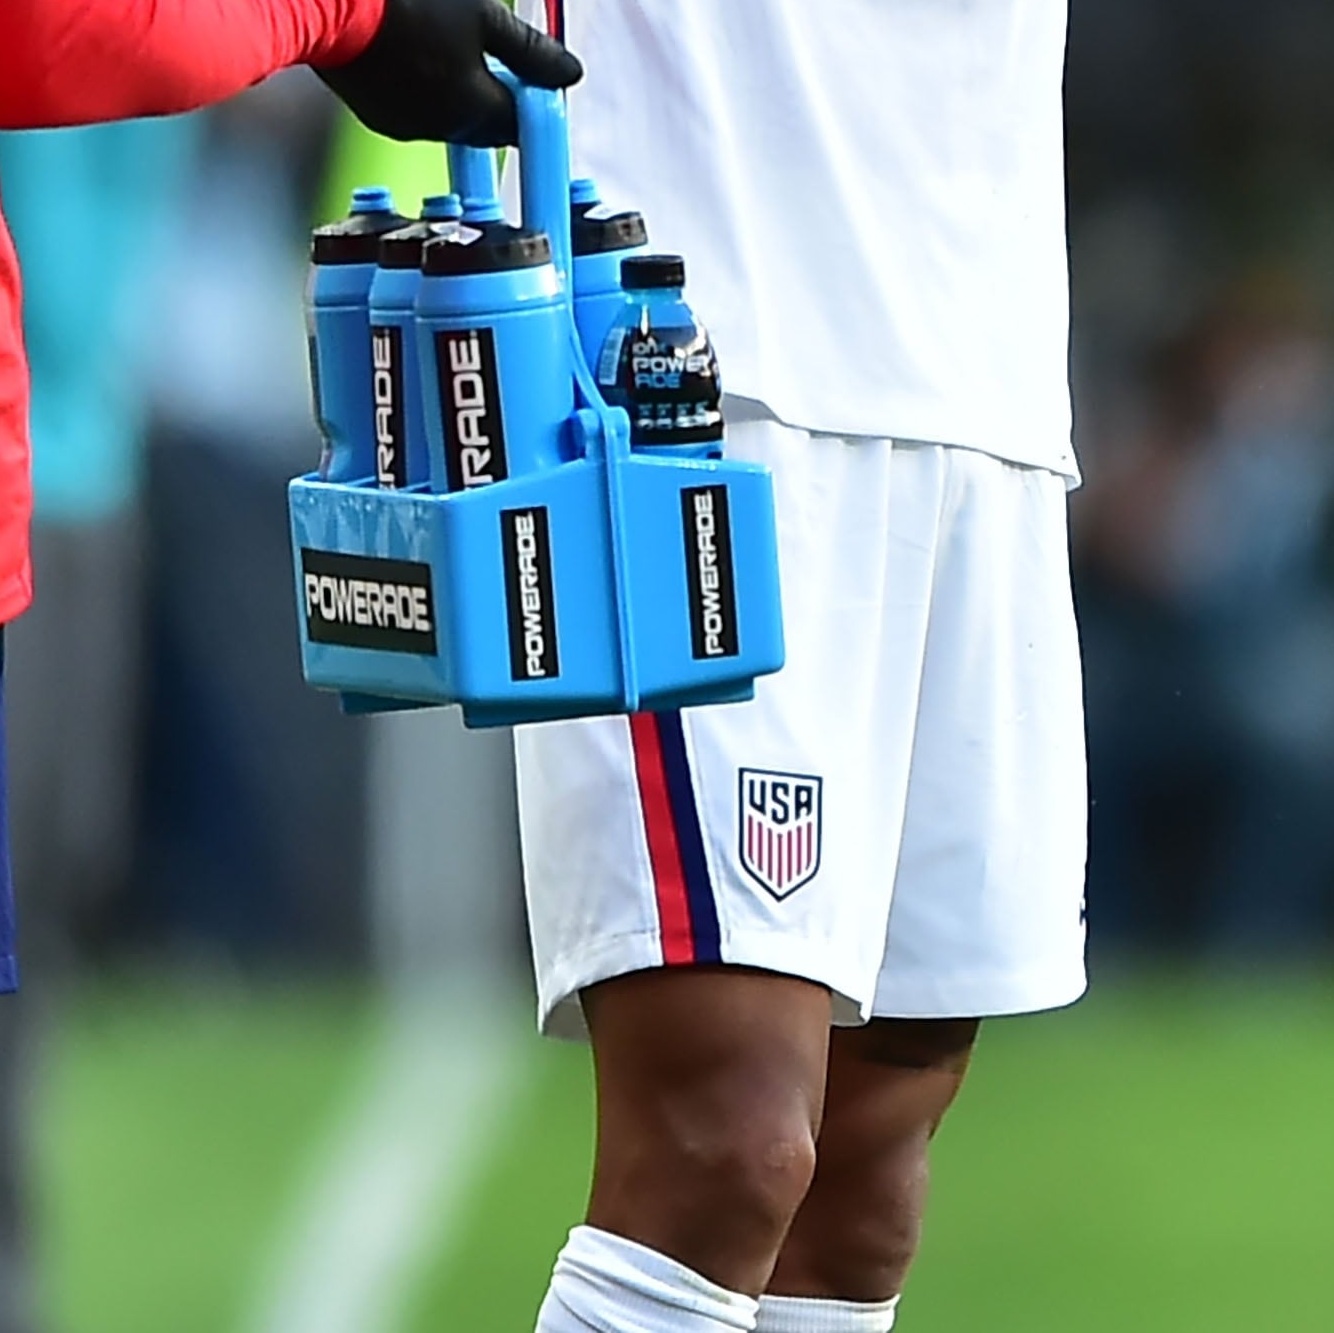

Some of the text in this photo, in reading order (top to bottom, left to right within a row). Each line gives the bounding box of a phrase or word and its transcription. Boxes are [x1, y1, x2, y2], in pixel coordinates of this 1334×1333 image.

[373, 333, 395, 490] RADE
[449, 334, 493, 491] RADE
[305, 573, 431, 632] POWERADE
[515, 511, 545, 677] POWERADE
[694, 490, 724, 655] POWERADE
[749, 779, 813, 825] USA
